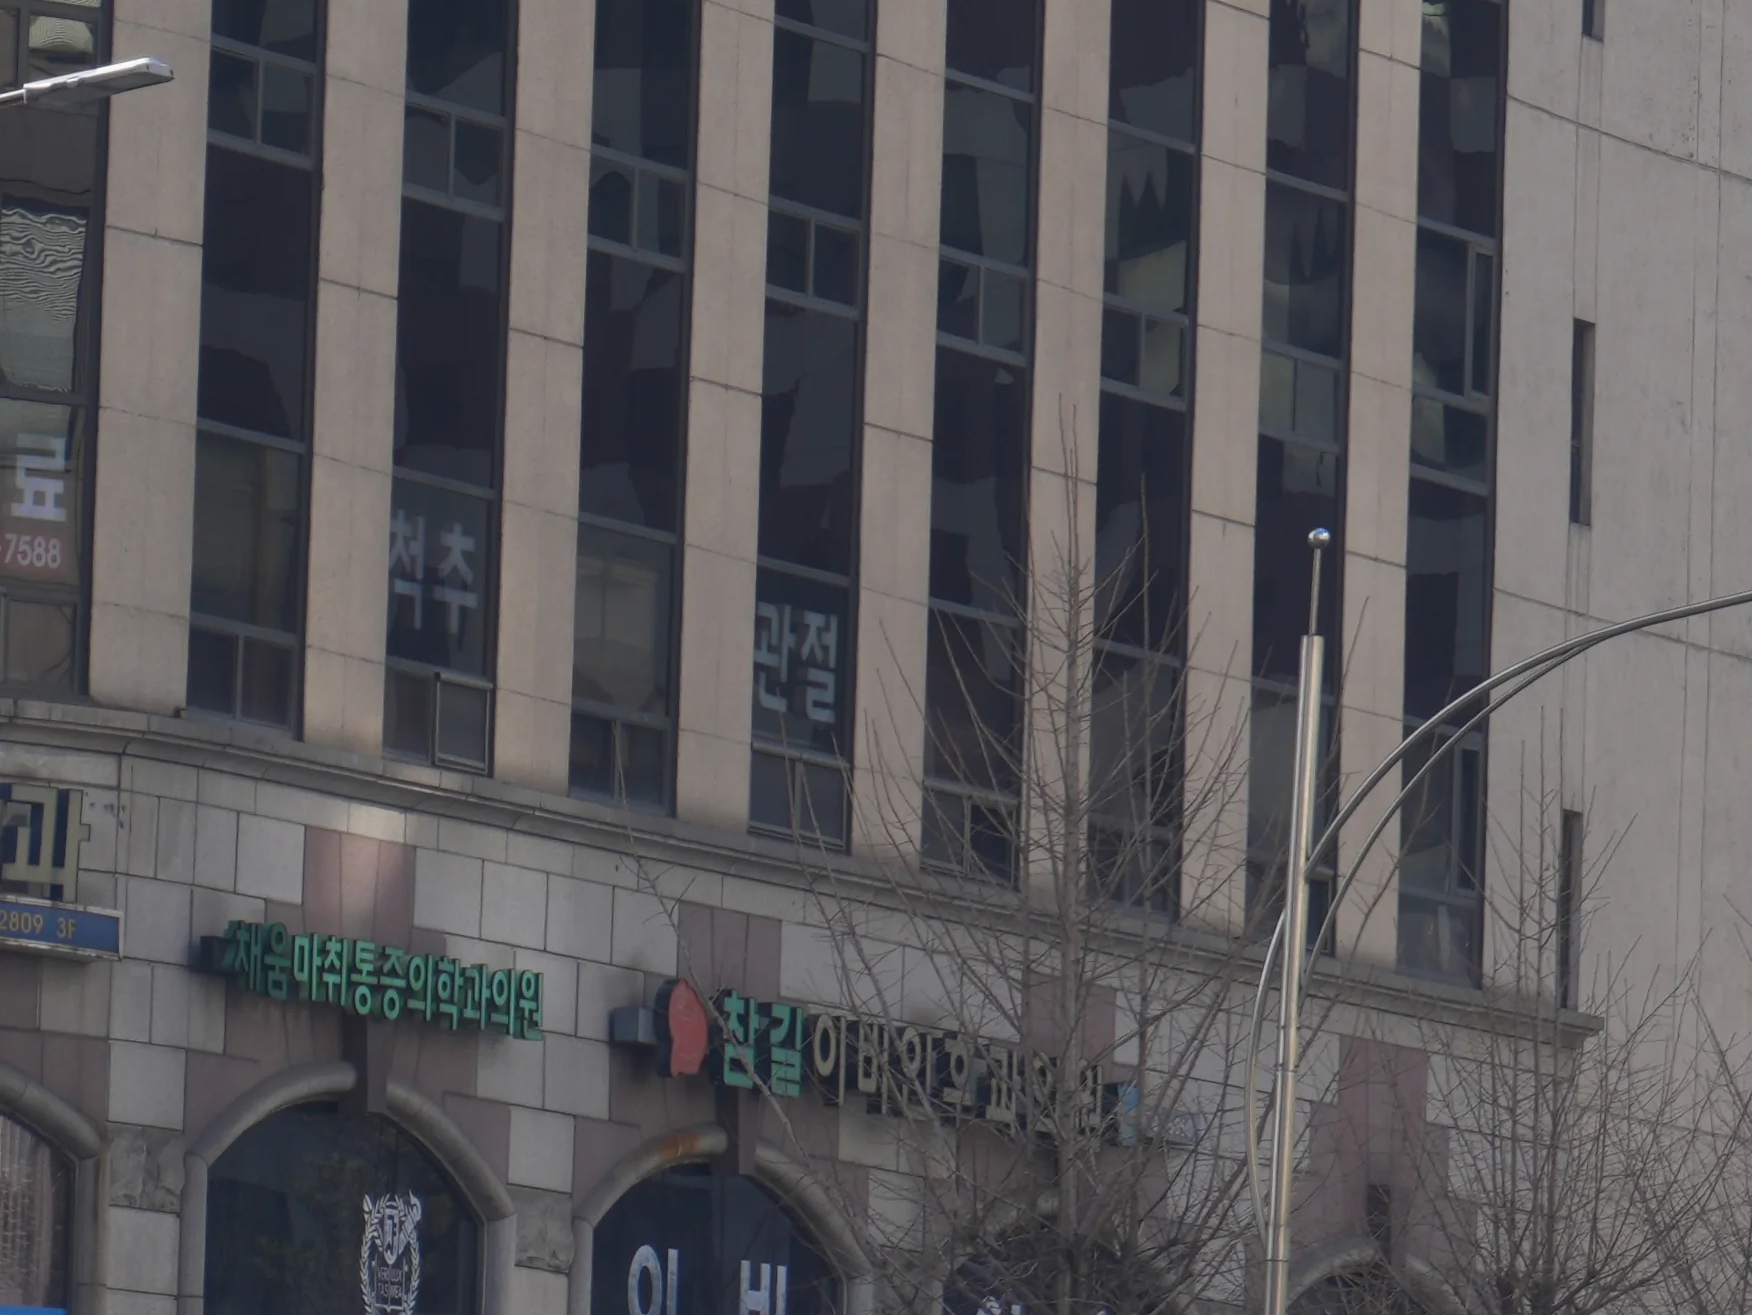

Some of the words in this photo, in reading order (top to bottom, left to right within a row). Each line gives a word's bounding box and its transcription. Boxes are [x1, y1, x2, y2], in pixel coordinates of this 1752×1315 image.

[389, 509, 478, 635] 척추
[755, 602, 838, 723] 관절
[56, 916, 76, 939] 3F
